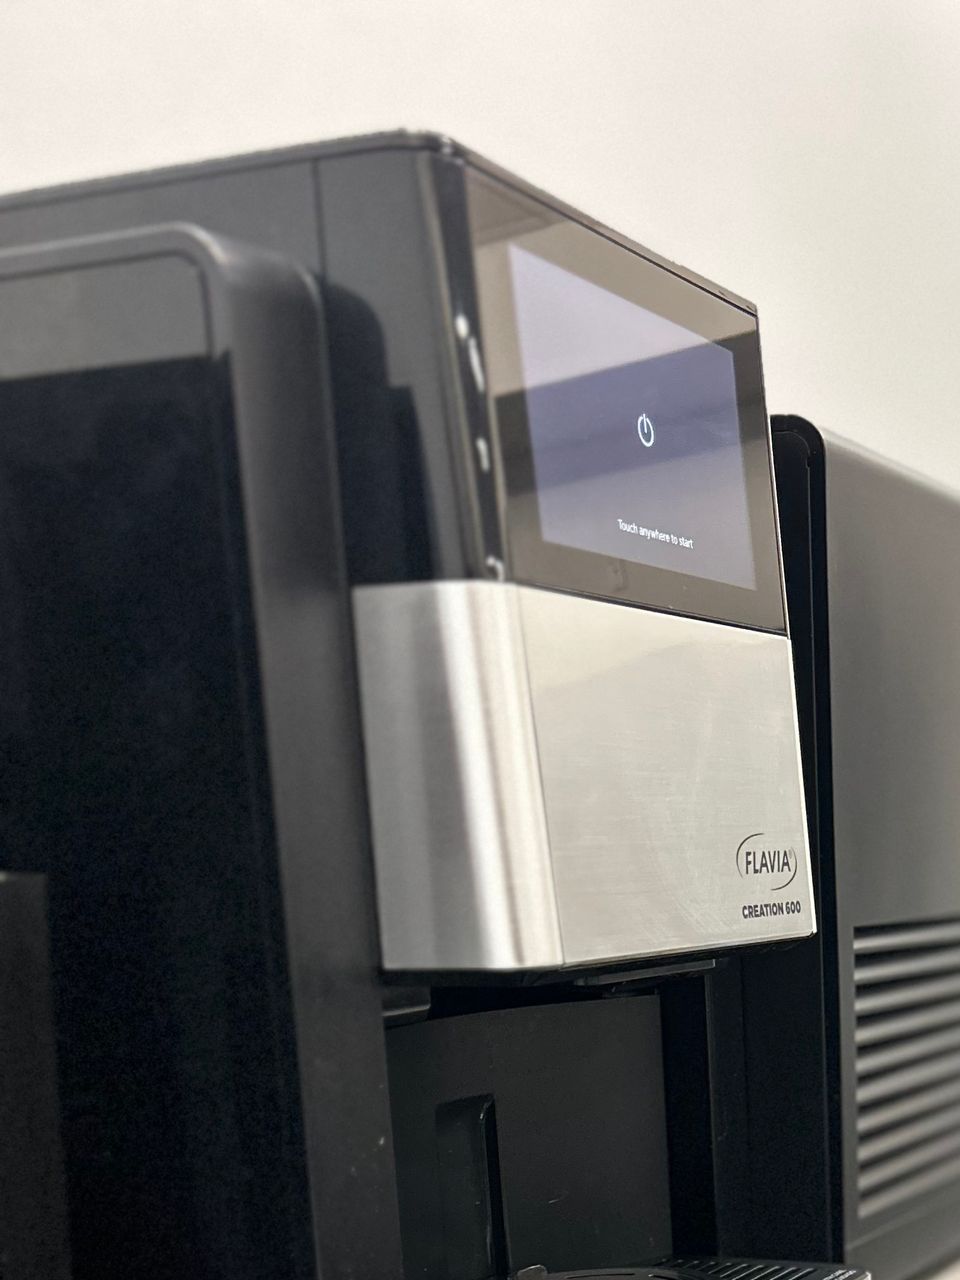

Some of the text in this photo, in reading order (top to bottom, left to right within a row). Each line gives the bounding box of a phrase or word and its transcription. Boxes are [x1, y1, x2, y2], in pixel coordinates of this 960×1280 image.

[617, 519, 693, 549] Touch anywhere to start
[745, 850, 791, 874] FLAVIA
[742, 901, 801, 919] CREATION 600
